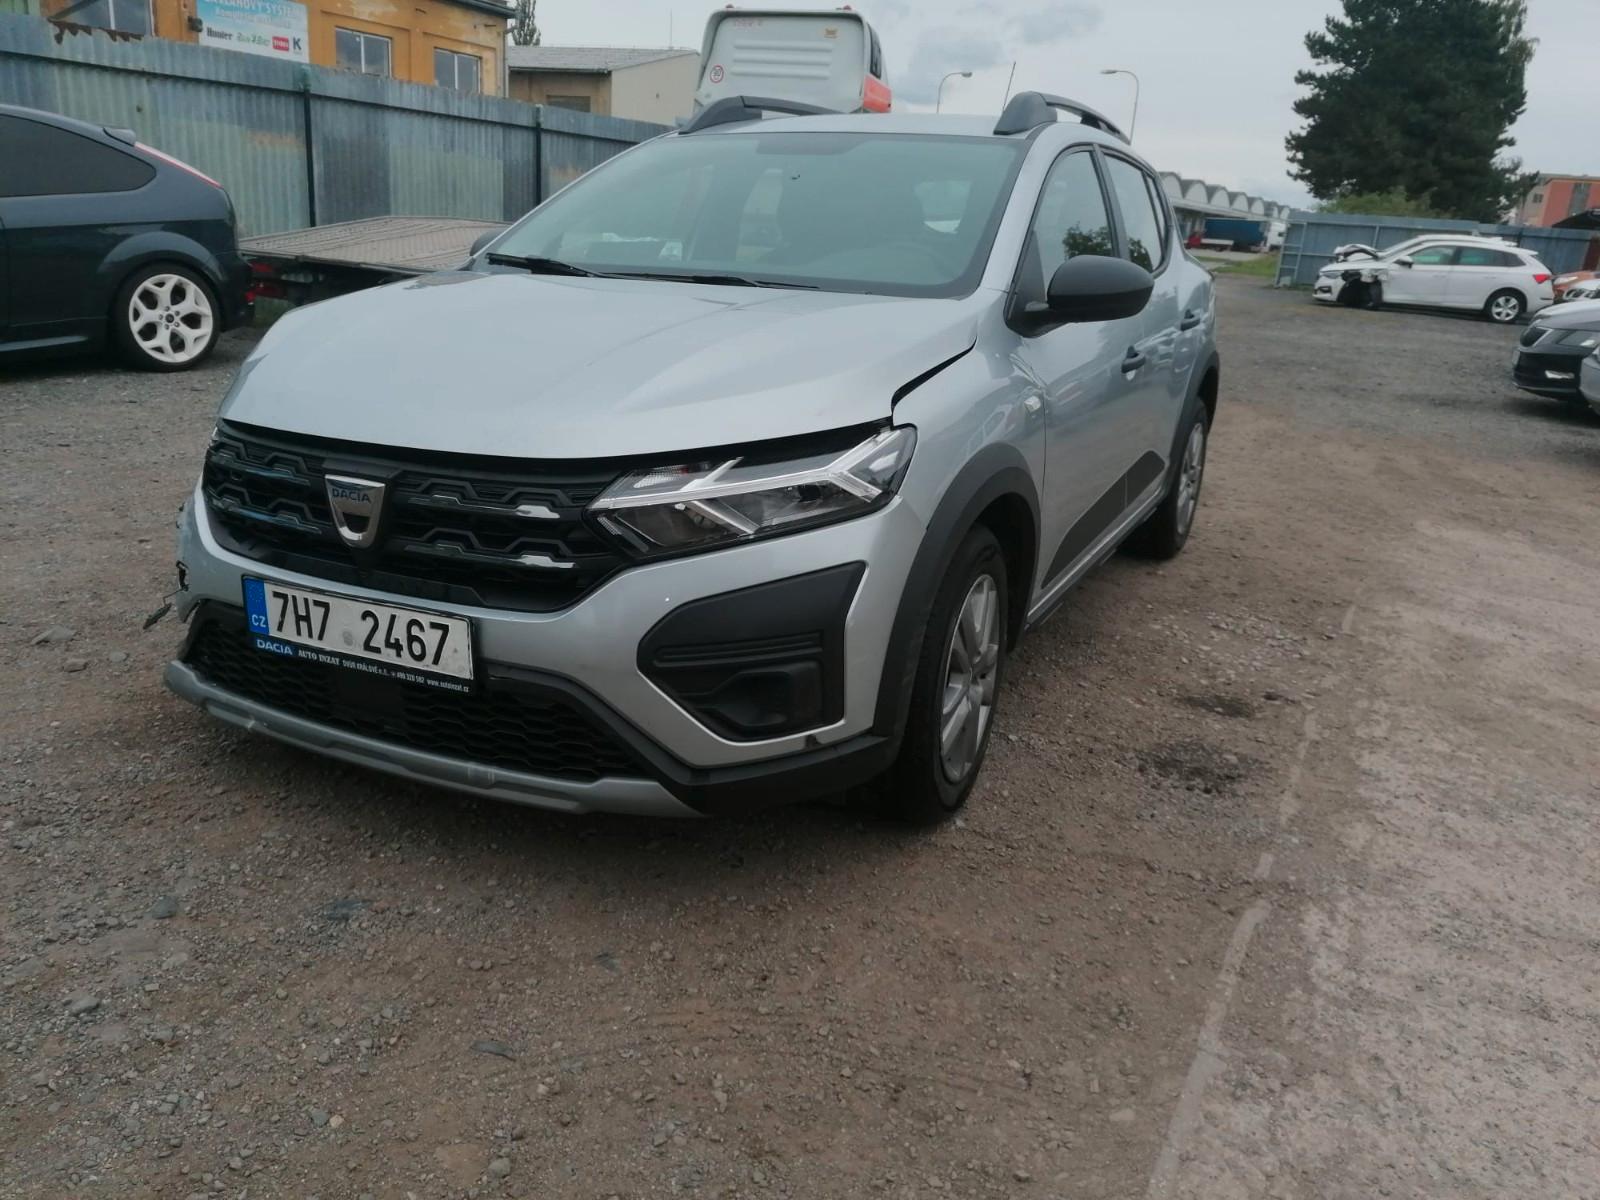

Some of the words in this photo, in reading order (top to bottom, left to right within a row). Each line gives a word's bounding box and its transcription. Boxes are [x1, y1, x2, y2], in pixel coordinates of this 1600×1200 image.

[332, 488, 372, 504] DACIA
[251, 614, 267, 628] CZ
[272, 590, 331, 641] 7H7
[360, 610, 450, 666] 2467
[256, 639, 293, 656] DACIA
[298, 649, 317, 660] AUTO
